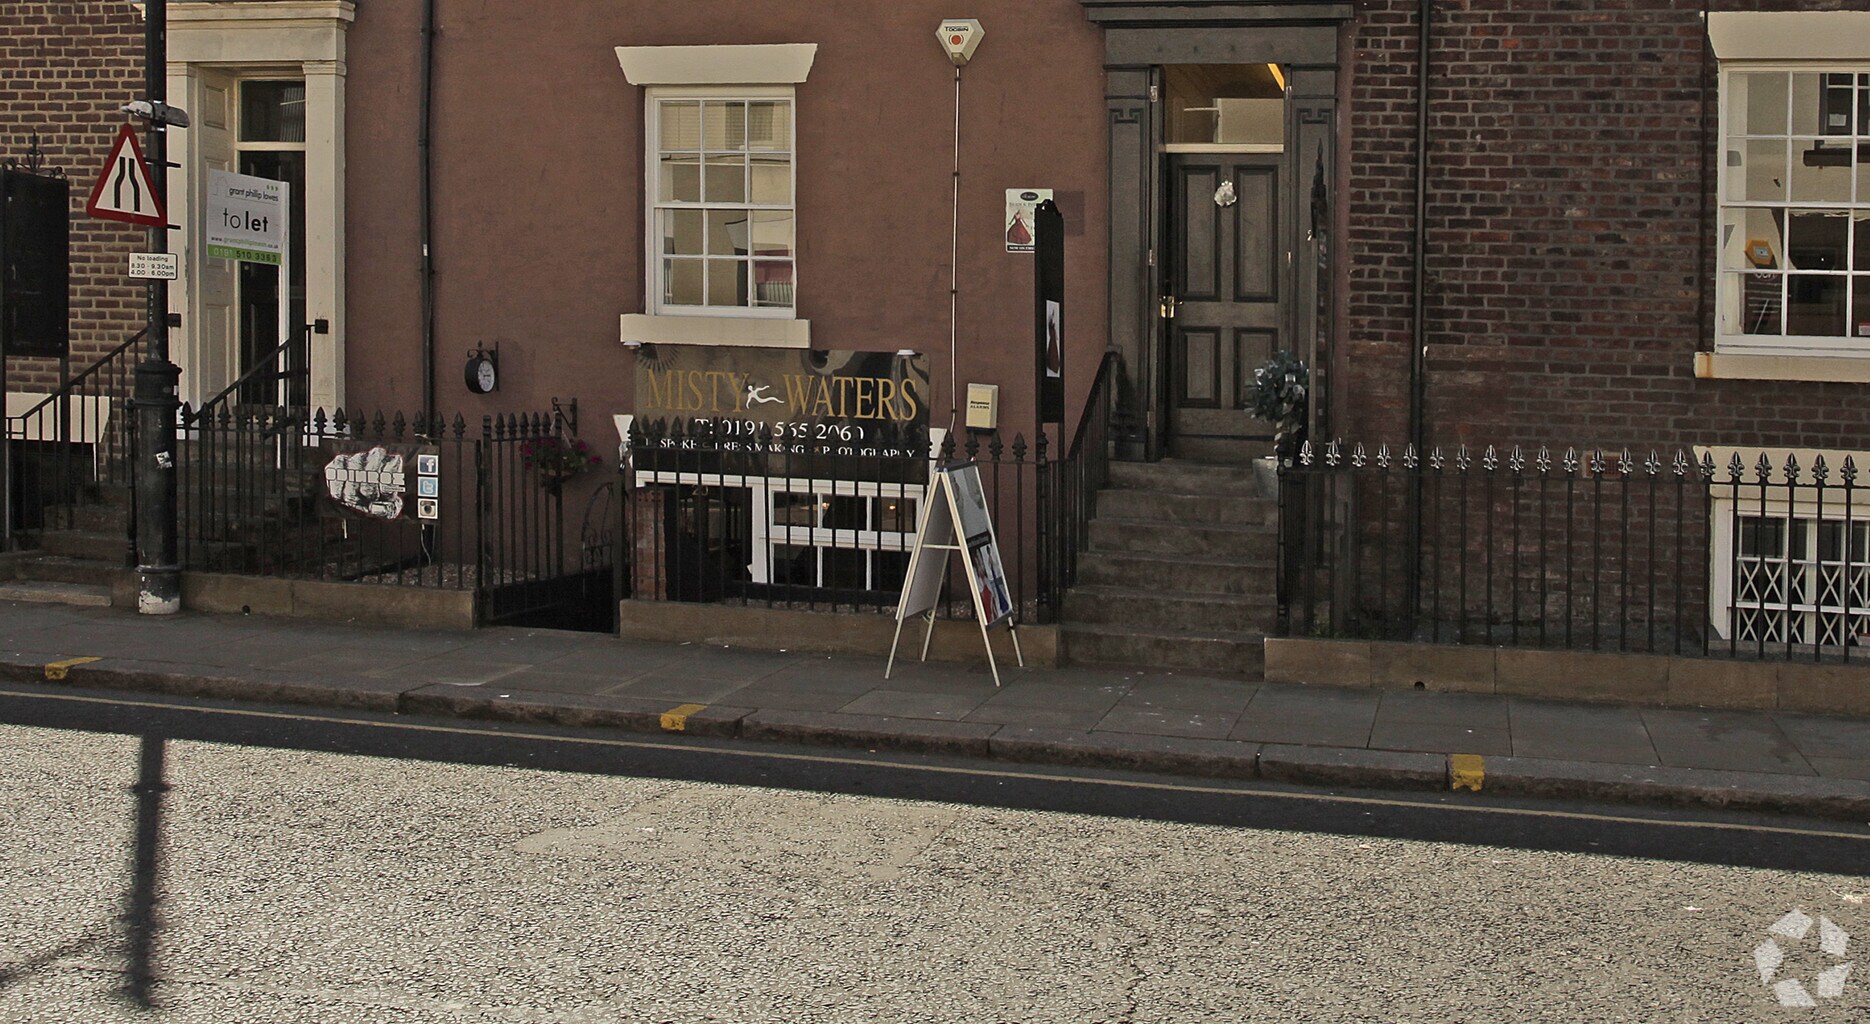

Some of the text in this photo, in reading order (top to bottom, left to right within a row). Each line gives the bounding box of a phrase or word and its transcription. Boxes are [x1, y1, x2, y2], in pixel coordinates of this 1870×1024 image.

[229, 187, 245, 196] grant
[223, 207, 268, 233] to let
[647, 369, 917, 421] MISTY WATERS
